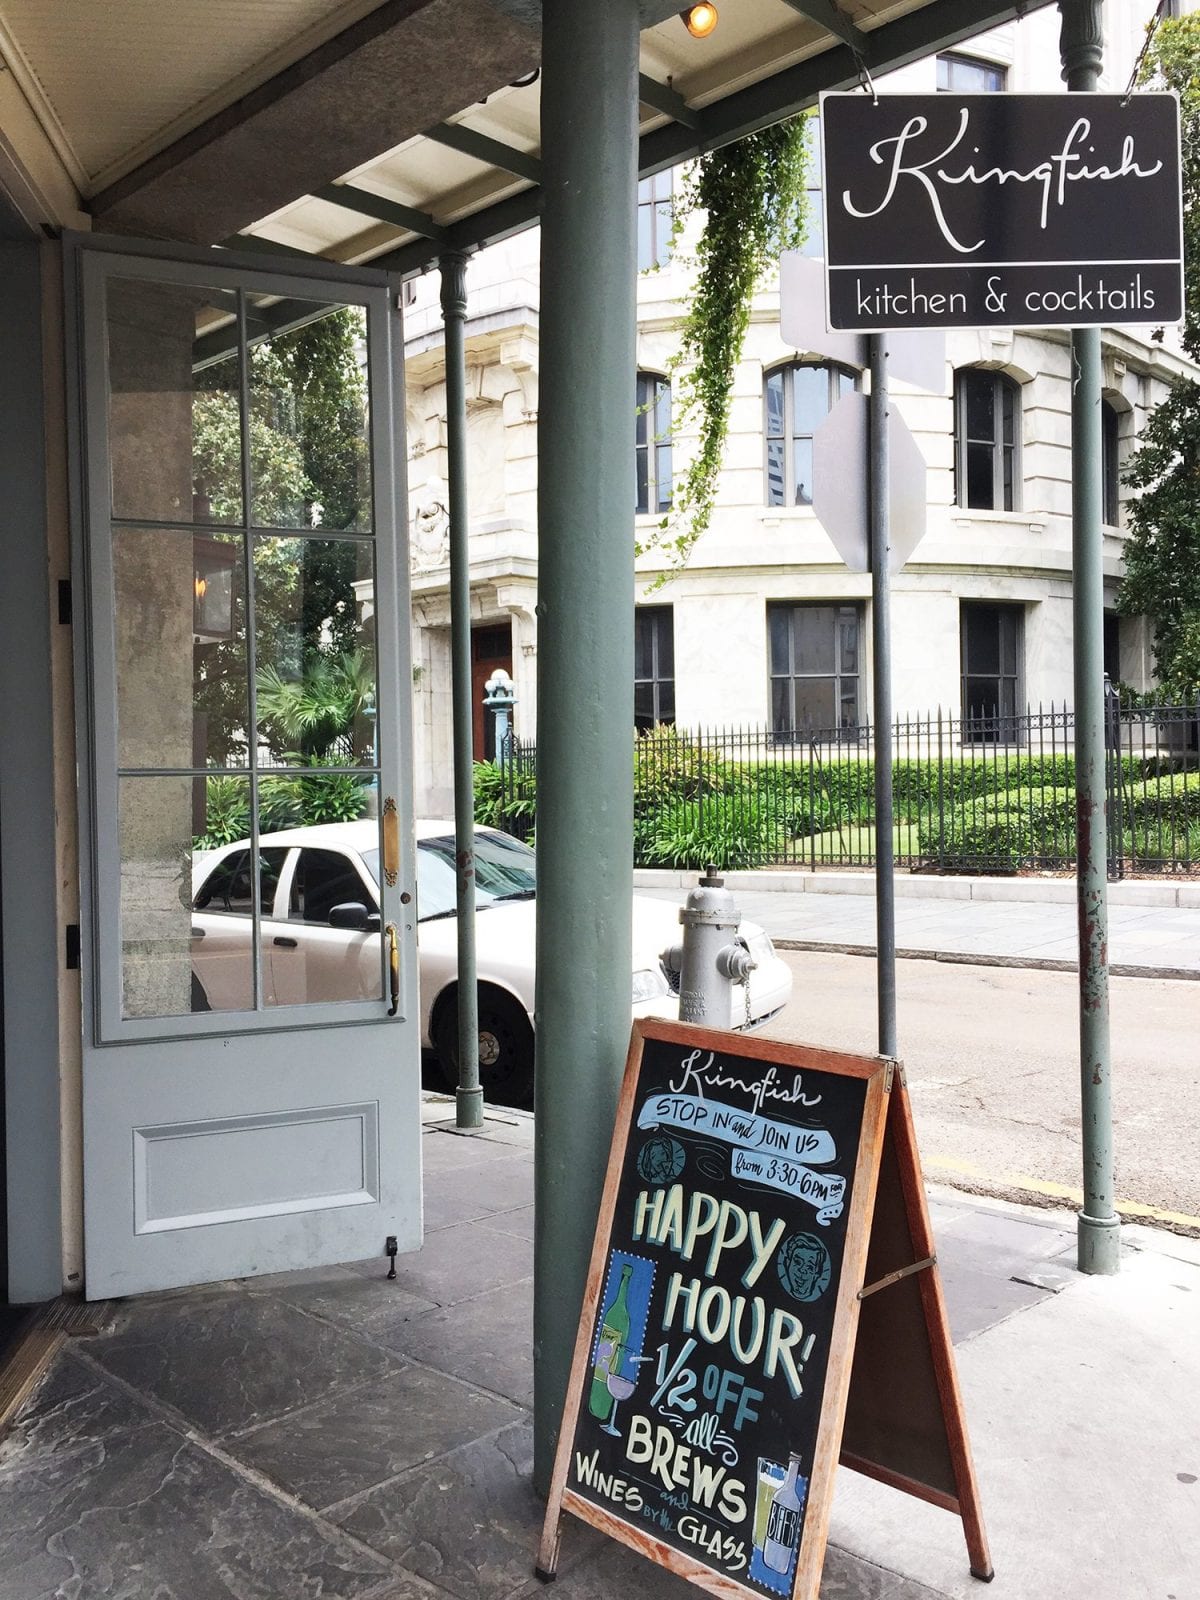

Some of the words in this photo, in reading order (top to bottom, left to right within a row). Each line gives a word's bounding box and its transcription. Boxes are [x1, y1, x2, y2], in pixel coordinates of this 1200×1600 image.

[842, 107, 1163, 253] Kingfish
[856, 277, 967, 316] kitchen
[984, 276, 1008, 313] &
[1025, 273, 1156, 312] cocktails
[669, 1049, 823, 1116] Kingfish
[656, 1098, 708, 1126] STOP
[712, 1112, 730, 1129] IN
[755, 1123, 790, 1147] JOIN
[795, 1134, 821, 1154] US
[735, 1152, 764, 1176] from
[632, 1184, 787, 1289] HAPPY
[662, 1272, 817, 1400] HOUR!
[649, 1337, 698, 1413] 1/2
[702, 1364, 765, 1432] OFF
[680, 1411, 720, 1456] all
[625, 1415, 748, 1524] BREWS
[659, 1491, 689, 1511] and
[643, 1504, 660, 1522] BY
[677, 1515, 747, 1571] GLASS
[768, 1503, 797, 1547] BEER
